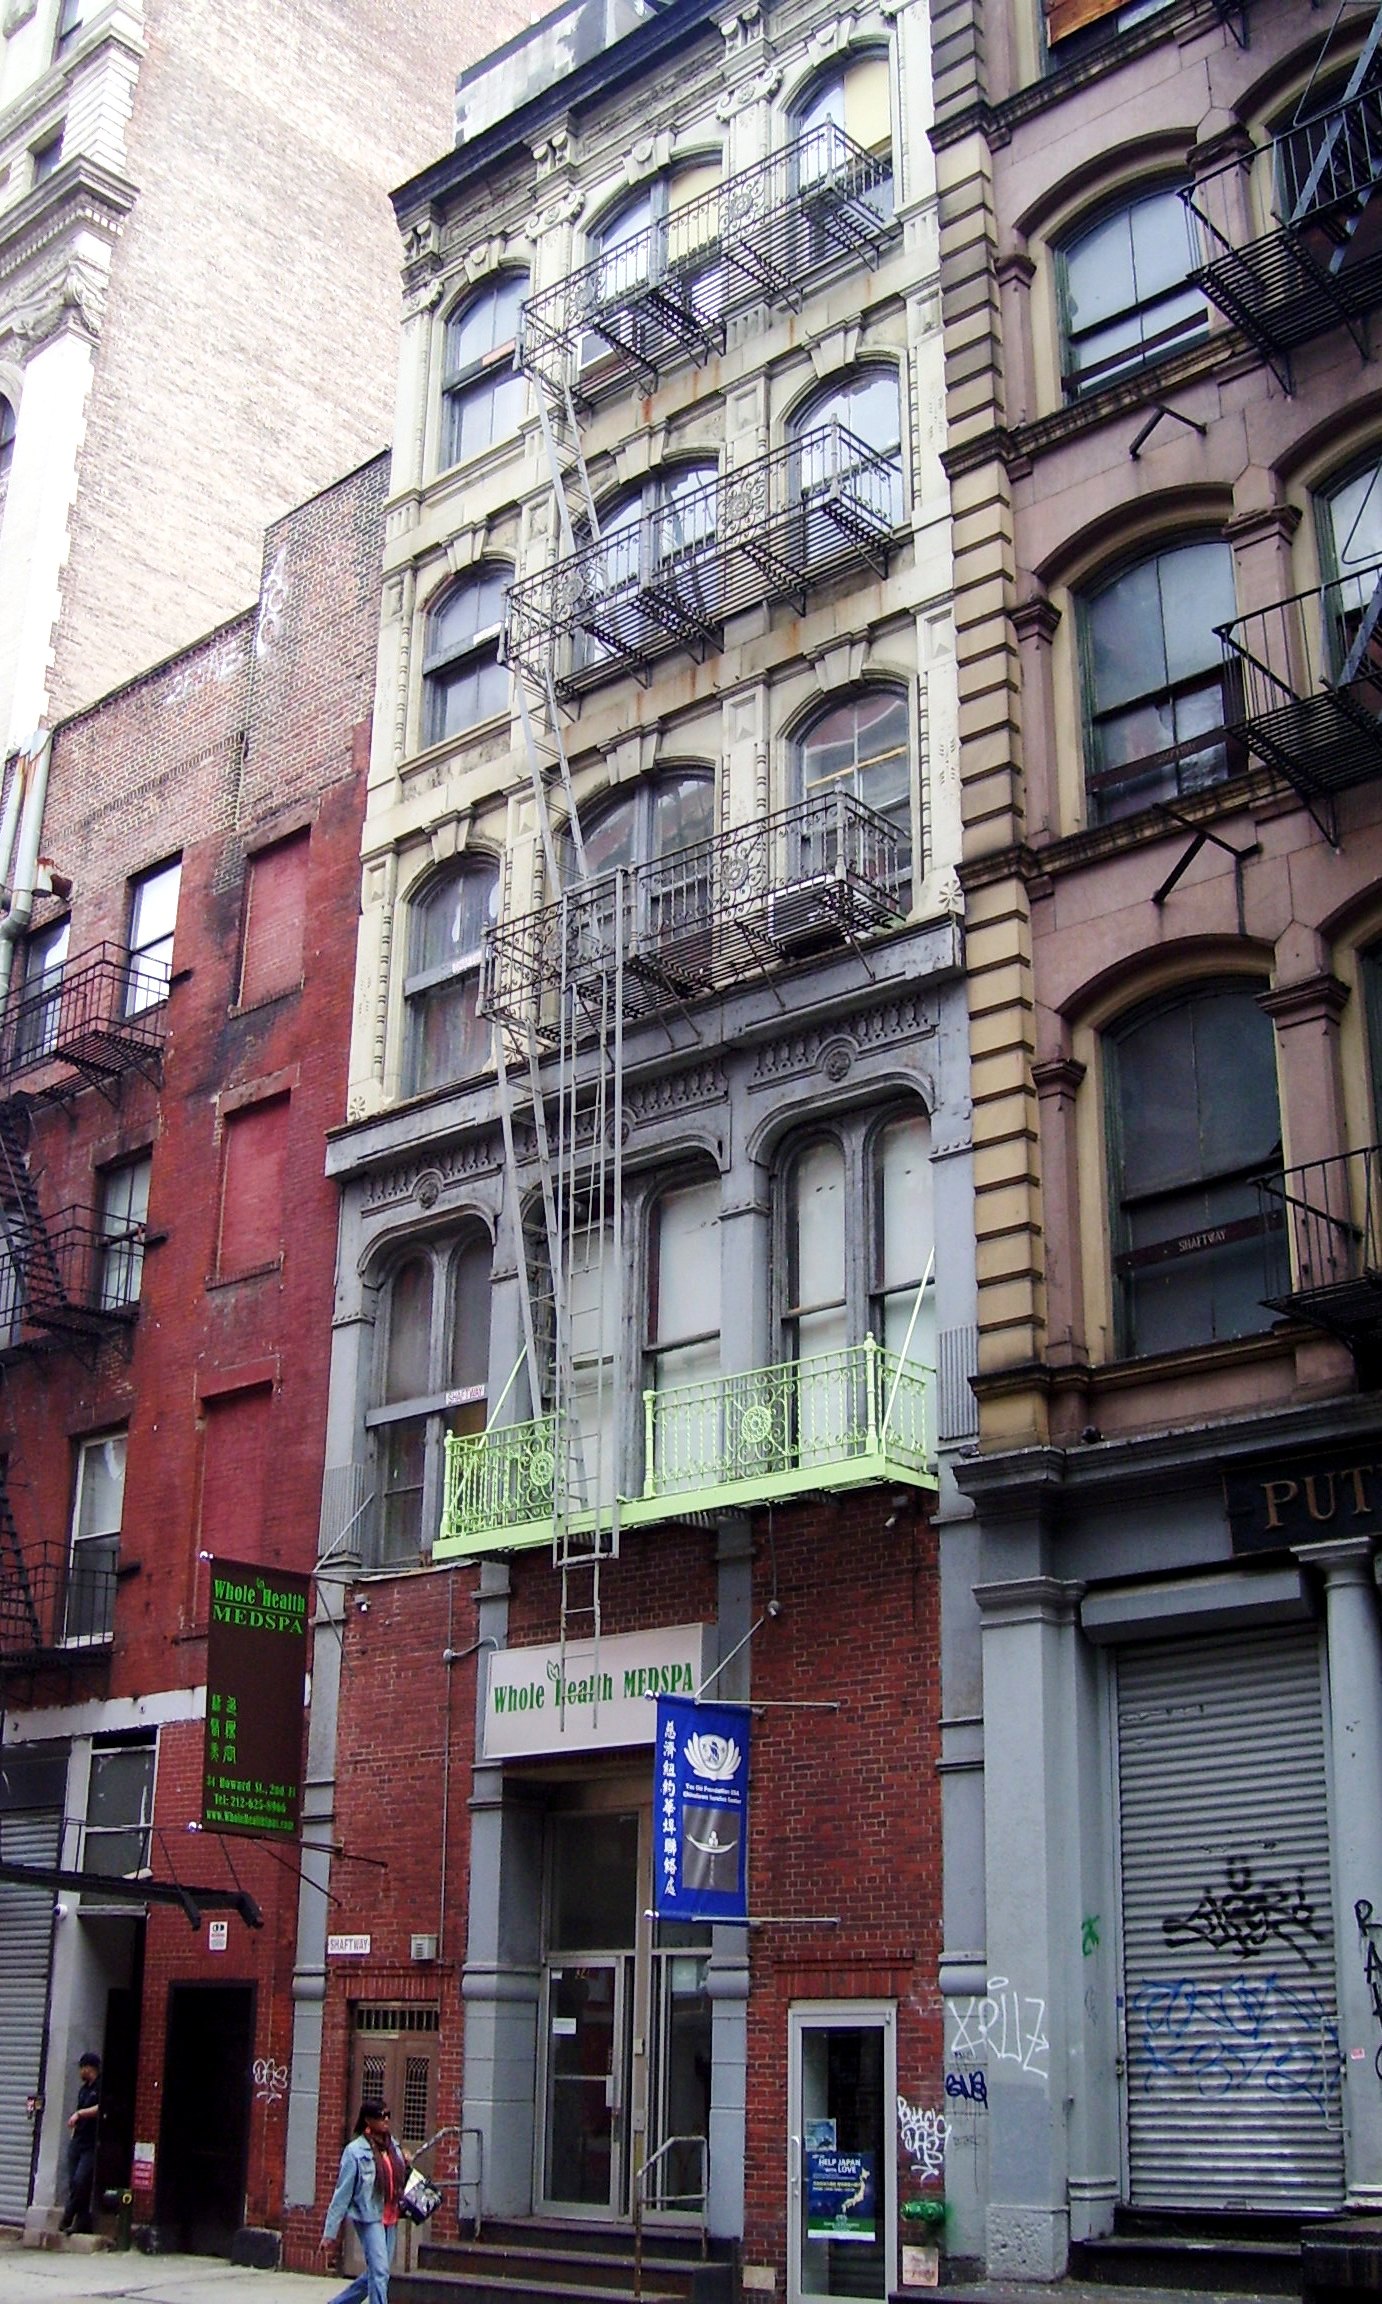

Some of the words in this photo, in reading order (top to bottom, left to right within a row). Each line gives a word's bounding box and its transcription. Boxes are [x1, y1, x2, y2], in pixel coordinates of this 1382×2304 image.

[1179, 1229, 1226, 1252] SHAFTWAY
[1260, 1464, 1382, 1529] PUT
[214, 1579, 256, 1605] Whole
[262, 1588, 305, 1613] Health
[213, 1604, 303, 1635] MEDSPA
[494, 1682, 545, 1713] Whole
[624, 1663, 694, 1699] MEDSPA
[219, 1776, 251, 1792] Howard
[330, 1938, 370, 1951] SHAFTWAY
[818, 2158, 837, 2167] HELP
[838, 2158, 861, 2167] JAPAN
[838, 2163, 857, 2174] LOVE
